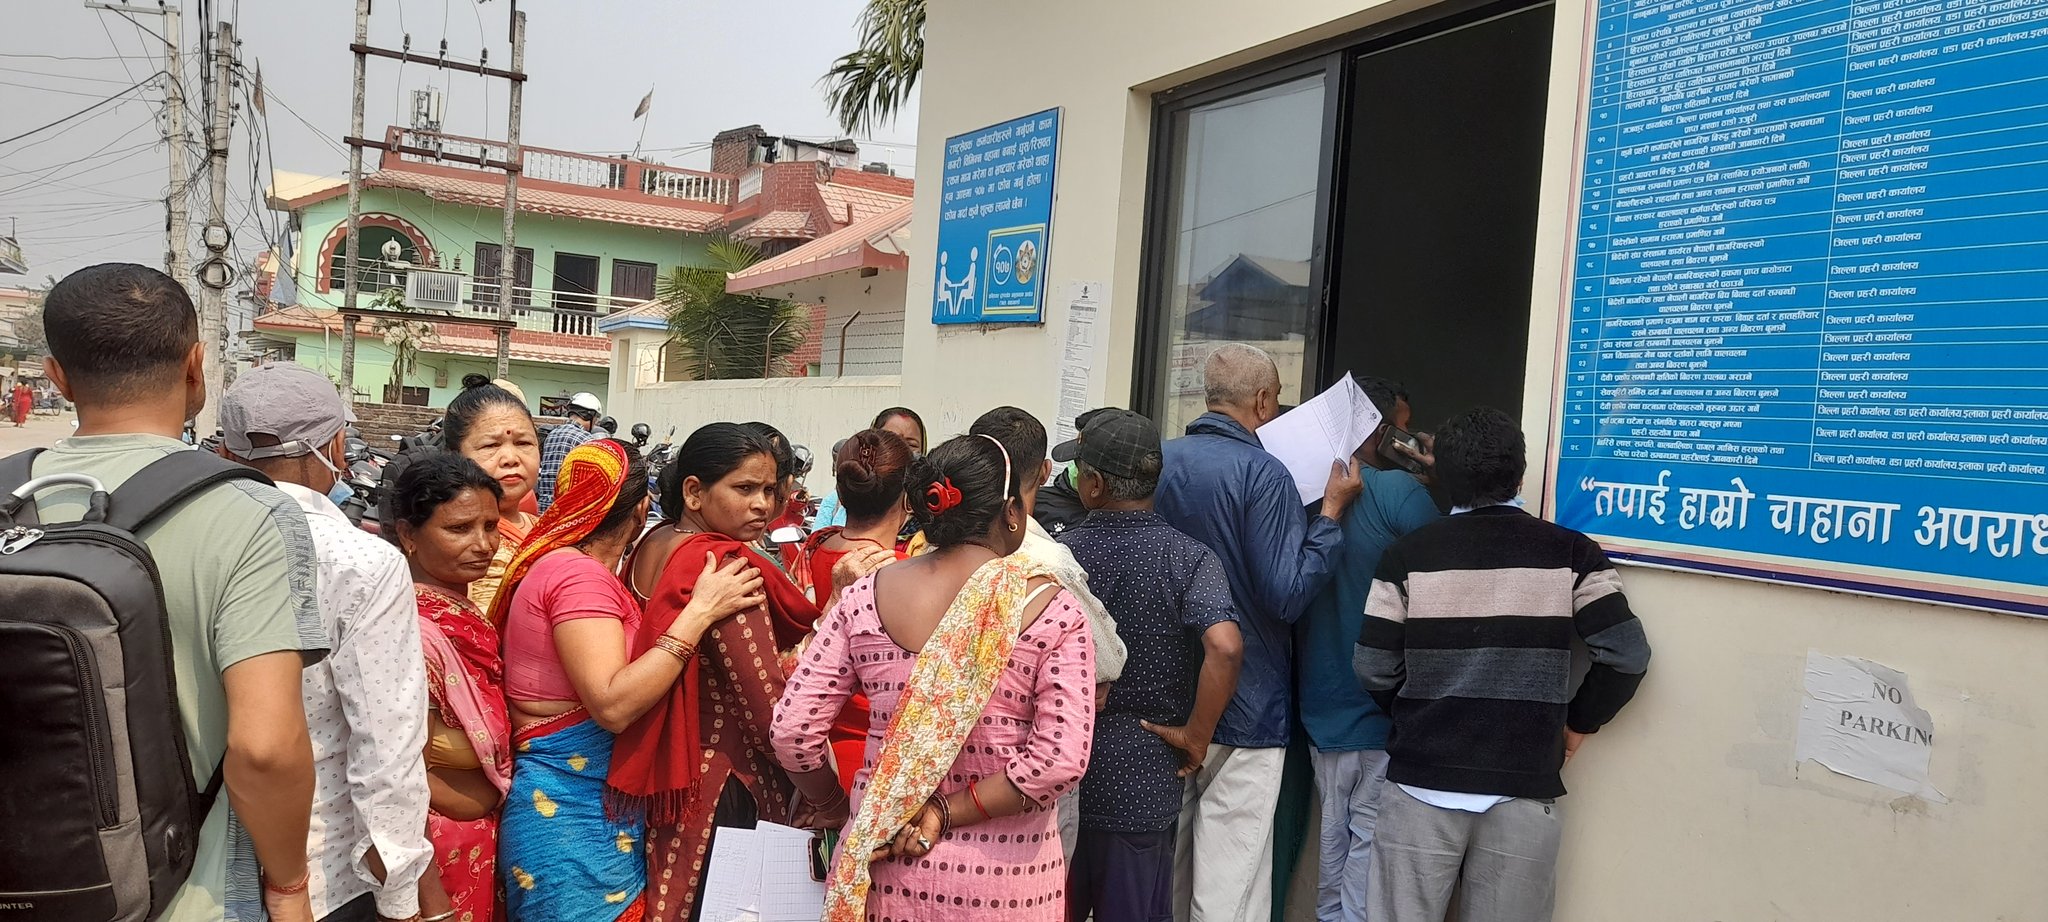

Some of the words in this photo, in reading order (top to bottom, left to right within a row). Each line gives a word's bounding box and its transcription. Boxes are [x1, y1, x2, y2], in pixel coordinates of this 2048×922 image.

[1851, 29, 1879, 41] जिल्ला
[1880, 22, 1902, 36] प्रहरी
[1945, 11, 1962, 22] वडा
[1964, 4, 1988, 19] प्रहरी
[1852, 16, 1880, 30] जिल्ला
[1881, 10, 1903, 24] प्रहरी
[1946, 0, 1963, 9] वडा
[1850, 41, 1878, 54] जिल्ला
[1879, 35, 1901, 49] प्रहरी
[1944, 25, 1961, 35] वडा
[1962, 18, 1986, 33] प्रहरी
[1849, 60, 1876, 72] जिल्ला
[1877, 53, 1899, 67] प्रहरी
[1942, 44, 1959, 54] वडा
[1961, 37, 1985, 51] प्रहरी
[1846, 88, 1874, 100] जिल्ला
[1875, 82, 1897, 96] प्रहरी
[1897, 77, 1936, 91] कार्यालय
[1038, 117, 1053, 131] काम
[1844, 114, 1871, 126] जिल्ला
[1872, 109, 1894, 122] प्रहरी
[1895, 104, 1933, 117] कार्यालय
[1842, 138, 1869, 149] जिल्ला
[1870, 133, 1892, 146] प्रहरी
[1893, 129, 1931, 142] कार्यालय
[1841, 153, 1868, 163] जिल्ला
[1869, 148, 1891, 160] प्रहरी
[1891, 144, 1930, 157] कार्यालय
[1839, 169, 1866, 180] जिल्ला
[1868, 164, 1889, 177] प्रहरी
[1890, 161, 1928, 173] कार्यालय
[974, 186, 985, 196] १०७
[1837, 192, 1864, 203] जिल्ला
[1865, 188, 1887, 200] प्रहरी
[1888, 185, 1926, 197] कार्यालय
[1835, 214, 1862, 224] जिल्ला
[1863, 210, 1885, 222] प्रहरी
[1886, 208, 1924, 219] कार्यालय
[1833, 237, 1860, 247] जिल्ला
[1861, 234, 1883, 245] प्रहरी
[1883, 232, 1922, 243] कार्यालय
[995, 261, 1010, 273] १०७
[1830, 265, 1857, 275] जिल्ला
[1859, 262, 1881, 274] प्रहरी
[1881, 261, 1919, 272] कार्यालय
[1828, 289, 1855, 299] जिल्ला
[1856, 287, 1878, 298] प्रहरी
[1878, 286, 1917, 296] कार्यालय
[1826, 315, 1853, 325] जिल्ला
[1854, 313, 1875, 324] प्रहरी
[1876, 312, 1914, 323] कार्यालय
[1824, 333, 1851, 343] जिल्ला
[1852, 332, 1874, 343] प्रहरी
[1874, 332, 1913, 342] कार्यालय
[1822, 352, 1849, 362] जिल्ला
[1850, 351, 1872, 362] प्रहरी
[1872, 351, 1911, 361] कार्यालय
[1821, 371, 1847, 381] जिल्ला
[1849, 371, 1870, 382] प्रहरी
[1871, 371, 1909, 381] कार्यालय
[1819, 388, 1846, 399] जिल्ला
[1847, 389, 1869, 400] प्रहरी
[1869, 389, 1907, 400] कार्यालय
[1817, 404, 1840, 415] जिल्ला
[1841, 405, 1859, 416] प्रहरी
[1893, 408, 1907, 417] वडा
[1908, 406, 1928, 418] प्रहरी
[1991, 408, 2012, 420] प्रहरी
[1815, 426, 1838, 438] जिल्ला
[1839, 428, 1857, 439] प्रहरी
[1891, 431, 1905, 440] वडा
[1906, 430, 1926, 441] प्रहरी
[1989, 433, 2010, 445] प्रहरी
[2010, 434, 2048, 446] कार्यालय
[1813, 452, 1836, 464] जिल्ला
[1836, 454, 1855, 465] प्रहरी
[1888, 458, 1903, 467] वडा
[1904, 457, 1923, 468] प्रहरी
[1986, 461, 2007, 473] प्रहरी
[1679, 477, 1755, 530] हाम्रो
[1768, 494, 1901, 544] चाहाना
[1871, 682, 1902, 705] NO
[1840, 709, 1933, 747] PARKIN
